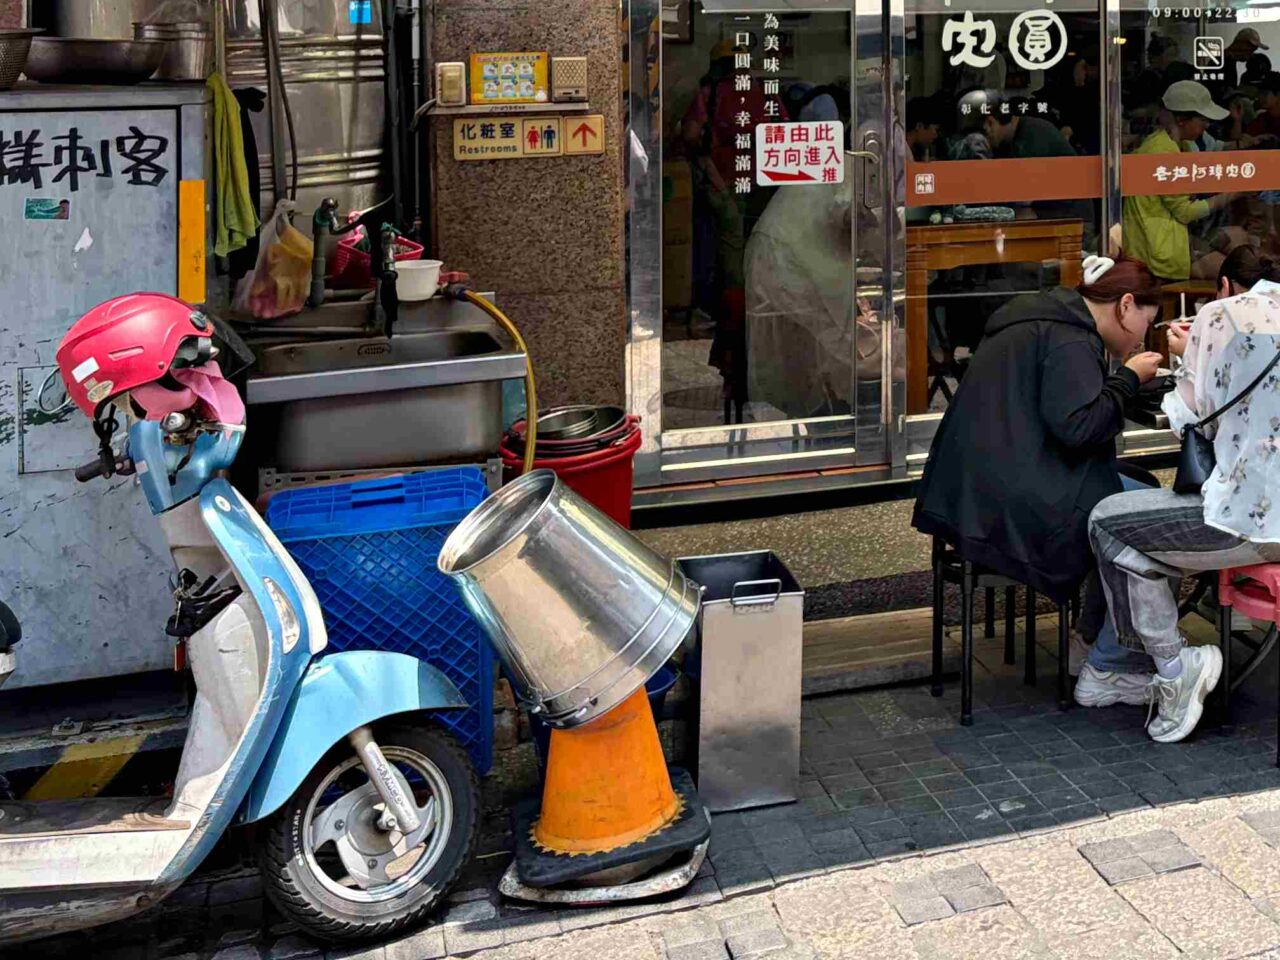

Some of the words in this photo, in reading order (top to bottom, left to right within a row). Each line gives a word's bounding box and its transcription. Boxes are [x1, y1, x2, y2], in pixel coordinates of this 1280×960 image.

[941, 9, 1068, 70] 肉圓
[763, 12, 780, 117] 為美味而生
[961, 102, 1049, 115] 彰化老字號
[460, 122, 515, 140] 化粧室
[764, 124, 834, 144] 請由此
[459, 145, 518, 154] Restrooms
[763, 146, 841, 167] 方向進入
[822, 167, 838, 182] 推
